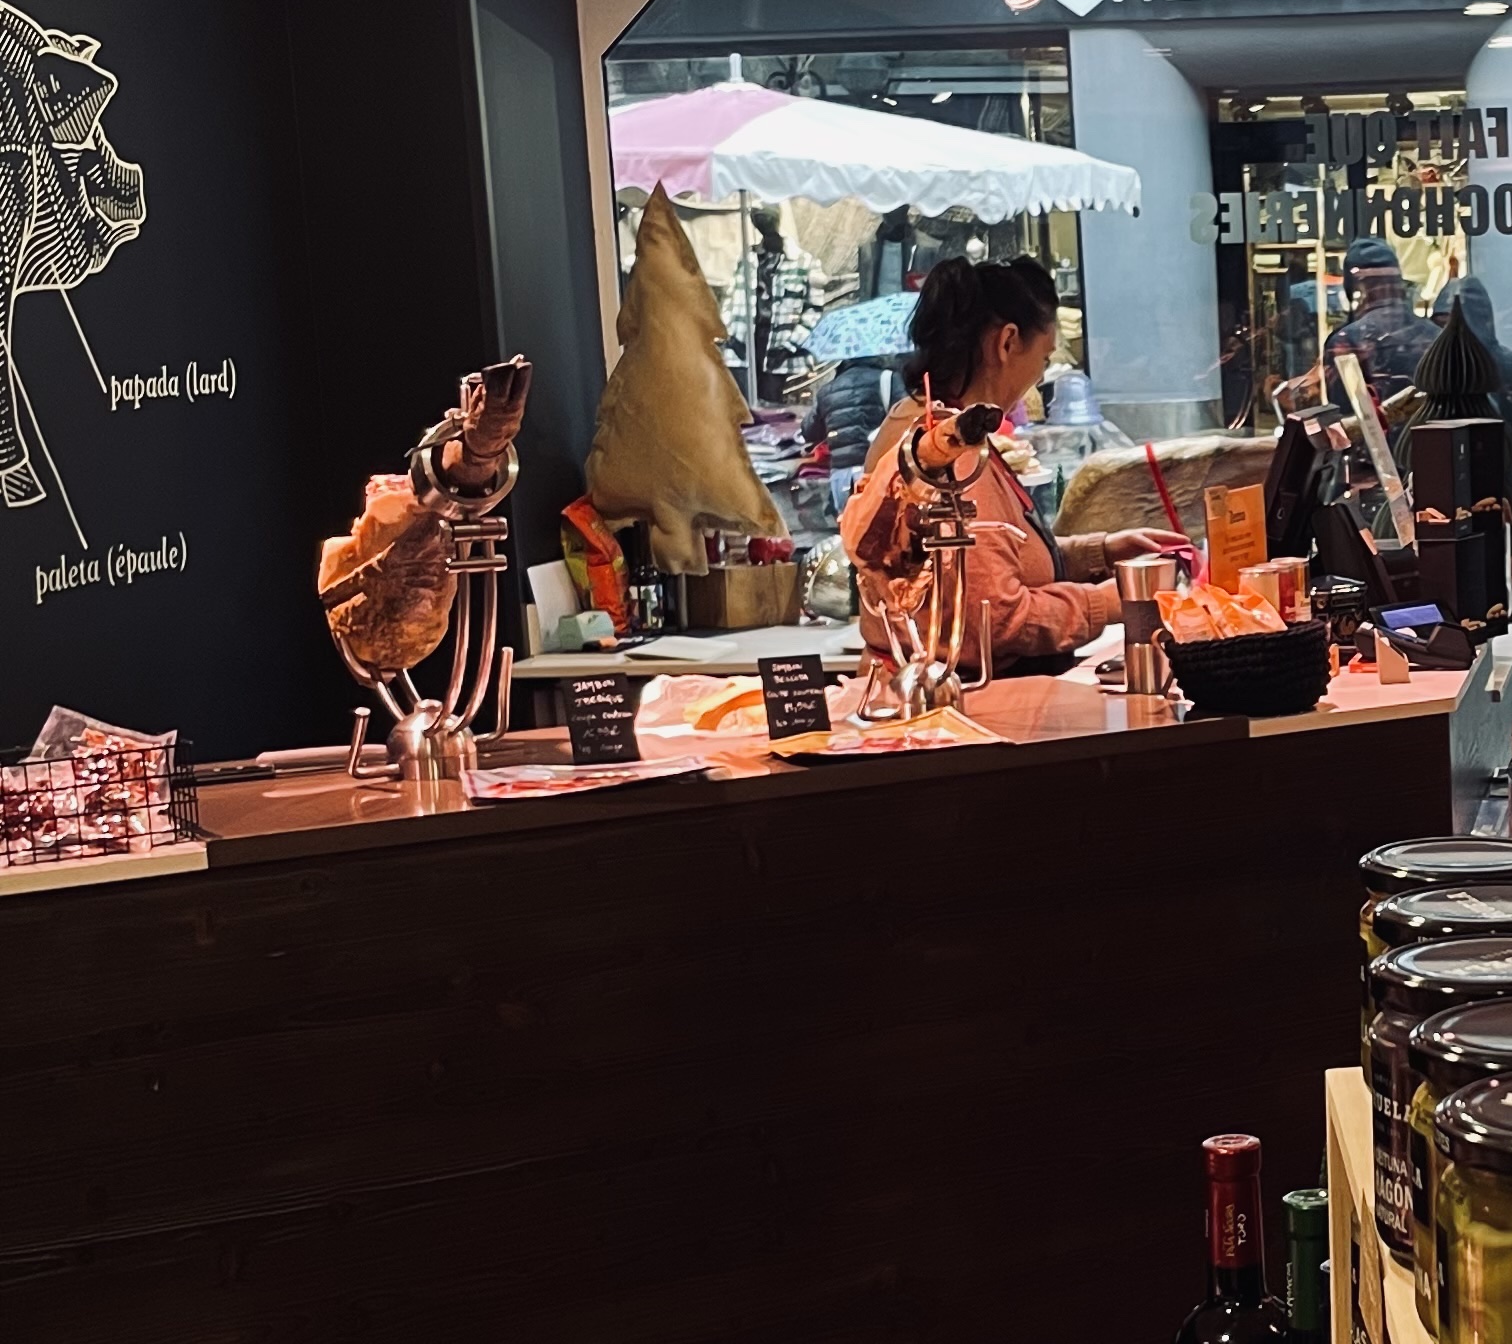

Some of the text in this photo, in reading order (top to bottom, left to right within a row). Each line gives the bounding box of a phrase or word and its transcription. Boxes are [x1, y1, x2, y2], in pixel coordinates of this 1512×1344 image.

[111, 358, 236, 411] papada (lard)
[36, 531, 187, 605] paleta (épaule)
